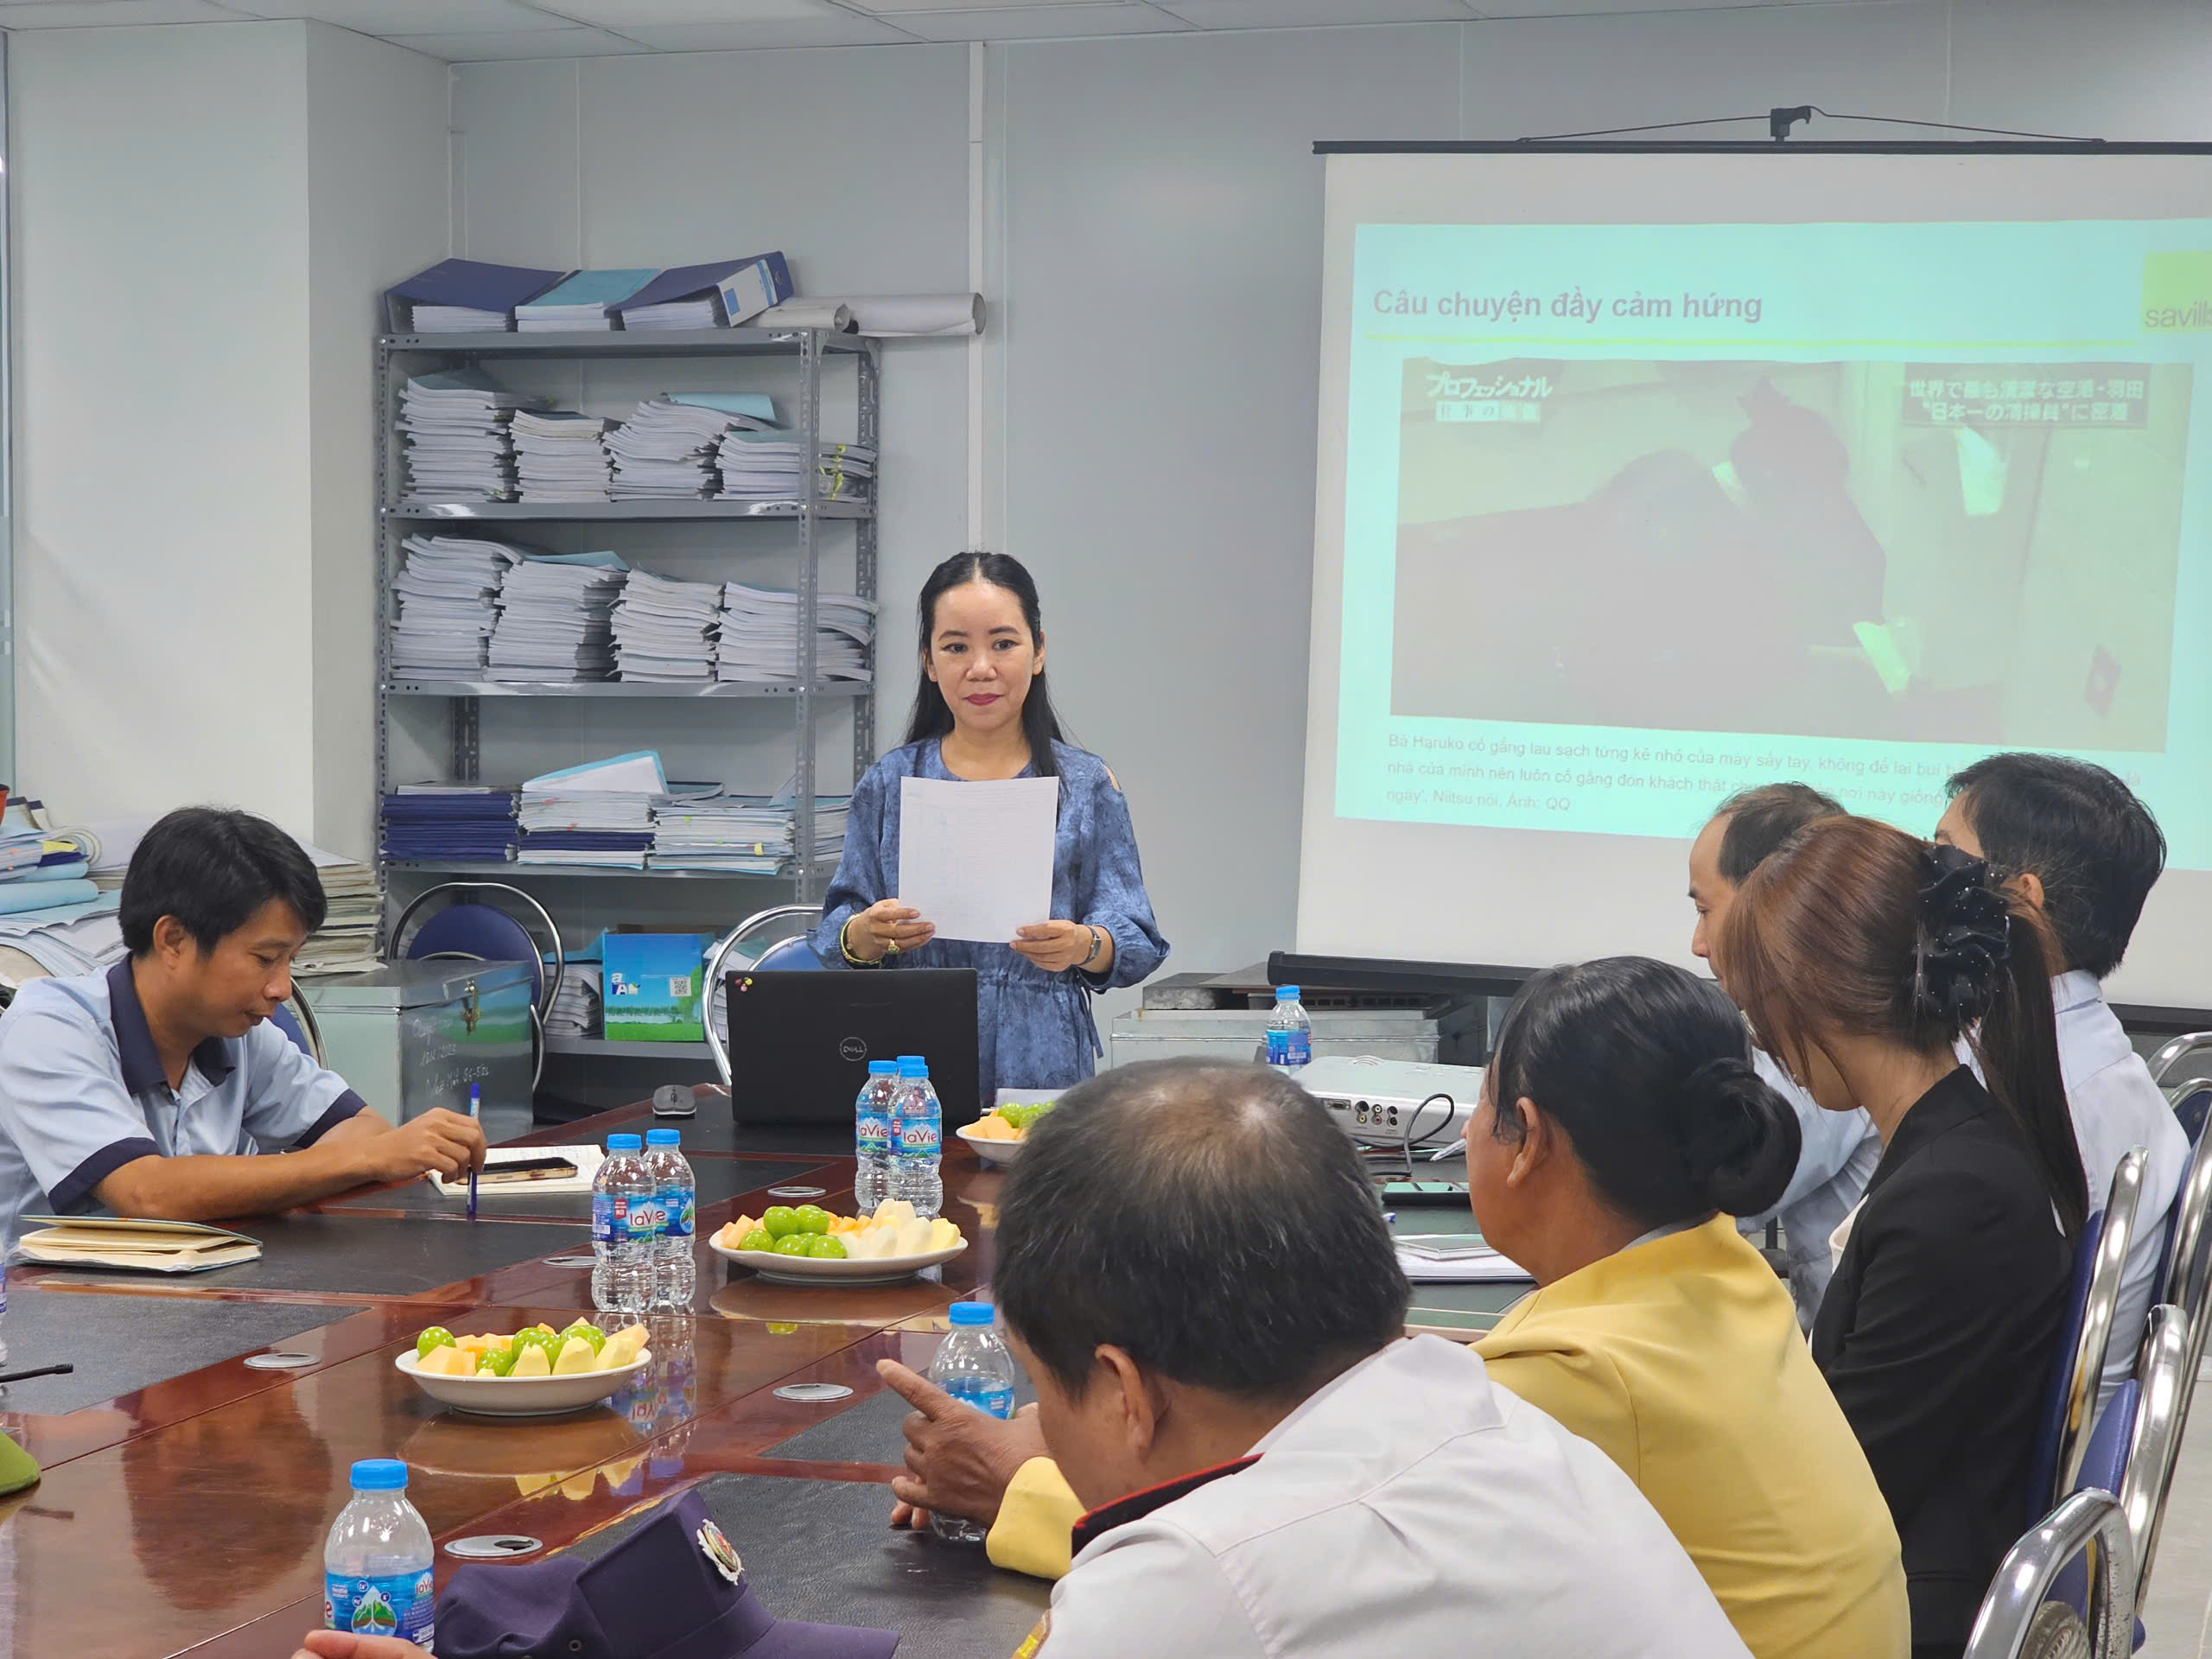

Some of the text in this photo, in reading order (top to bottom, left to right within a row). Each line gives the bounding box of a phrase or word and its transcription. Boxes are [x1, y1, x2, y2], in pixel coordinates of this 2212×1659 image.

[1373, 286, 1762, 323] Câu chuyện đầy cảm hứng
[1546, 797, 1571, 812] QQ
[903, 1129, 938, 1143] laVie
